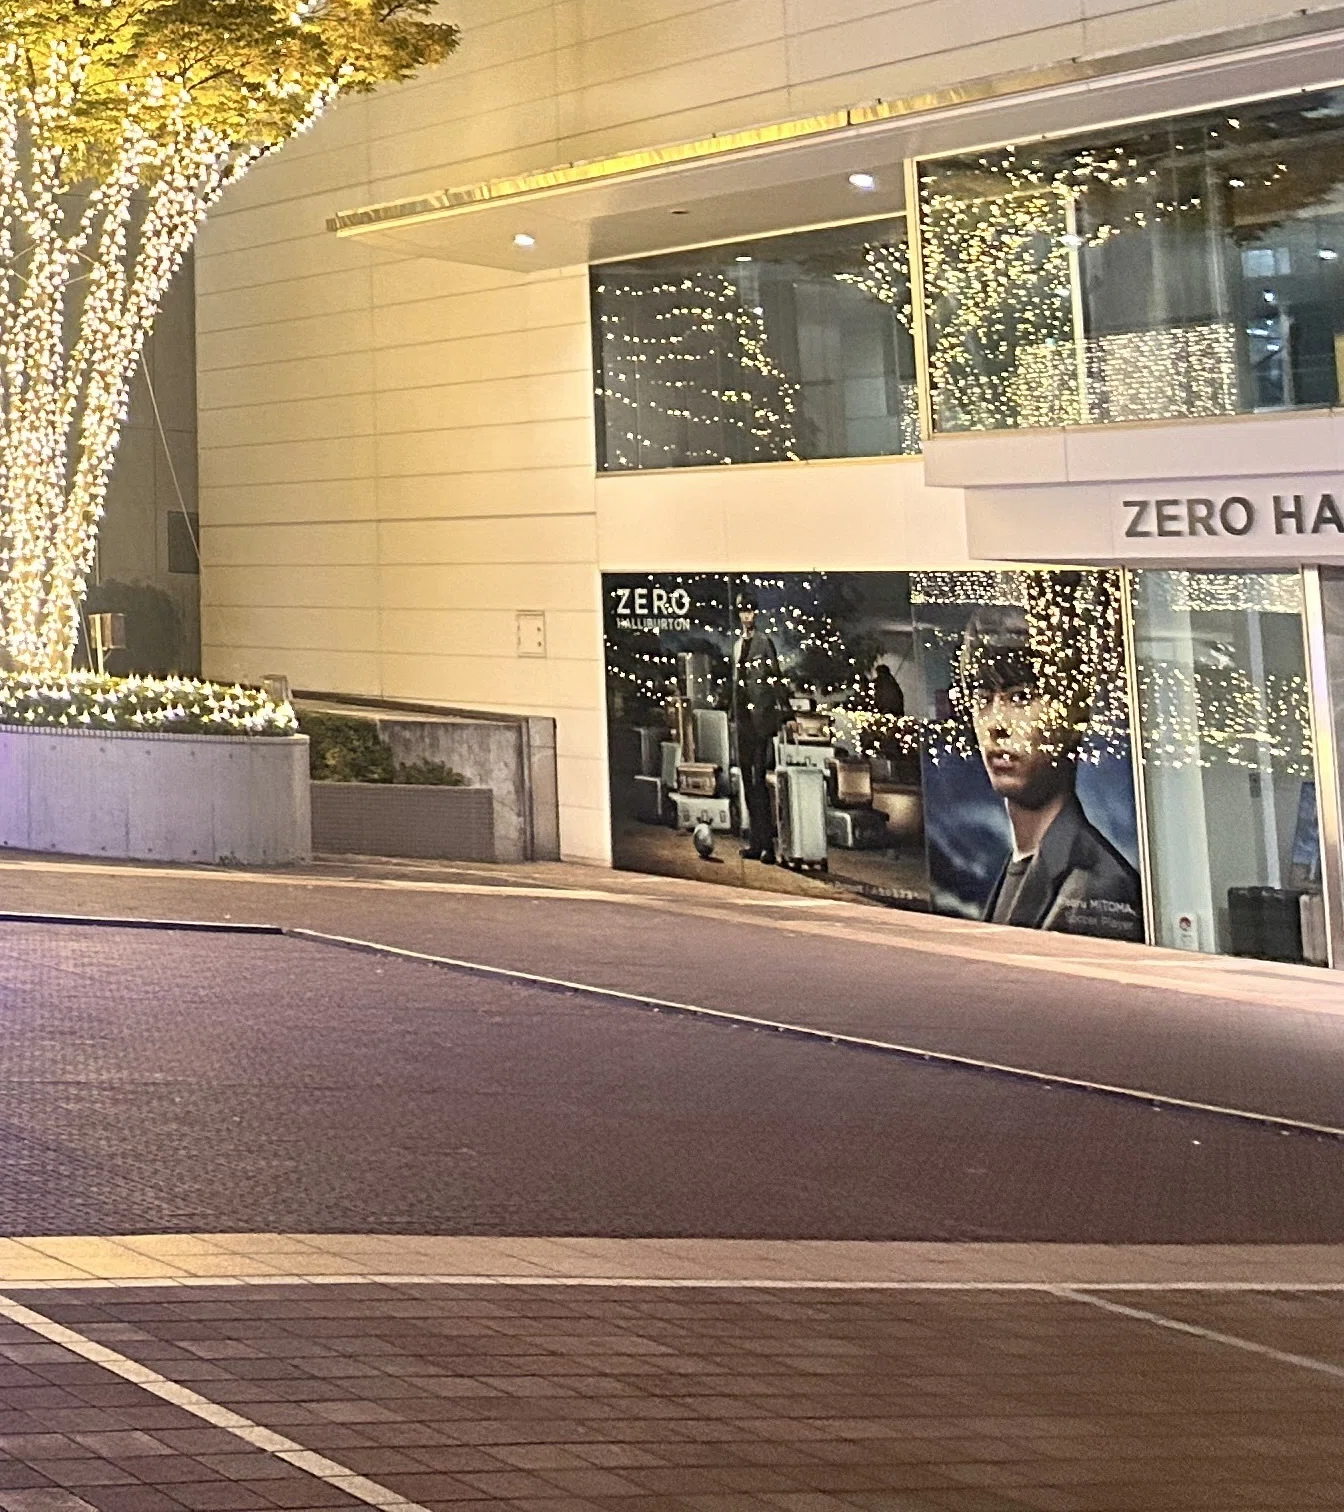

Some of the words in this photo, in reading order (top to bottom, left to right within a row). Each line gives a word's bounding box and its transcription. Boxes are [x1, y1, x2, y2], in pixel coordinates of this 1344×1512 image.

[1123, 496, 1255, 537] ZERO
[616, 588, 690, 615] ZERO
[616, 618, 690, 630] HALLIBURTON
